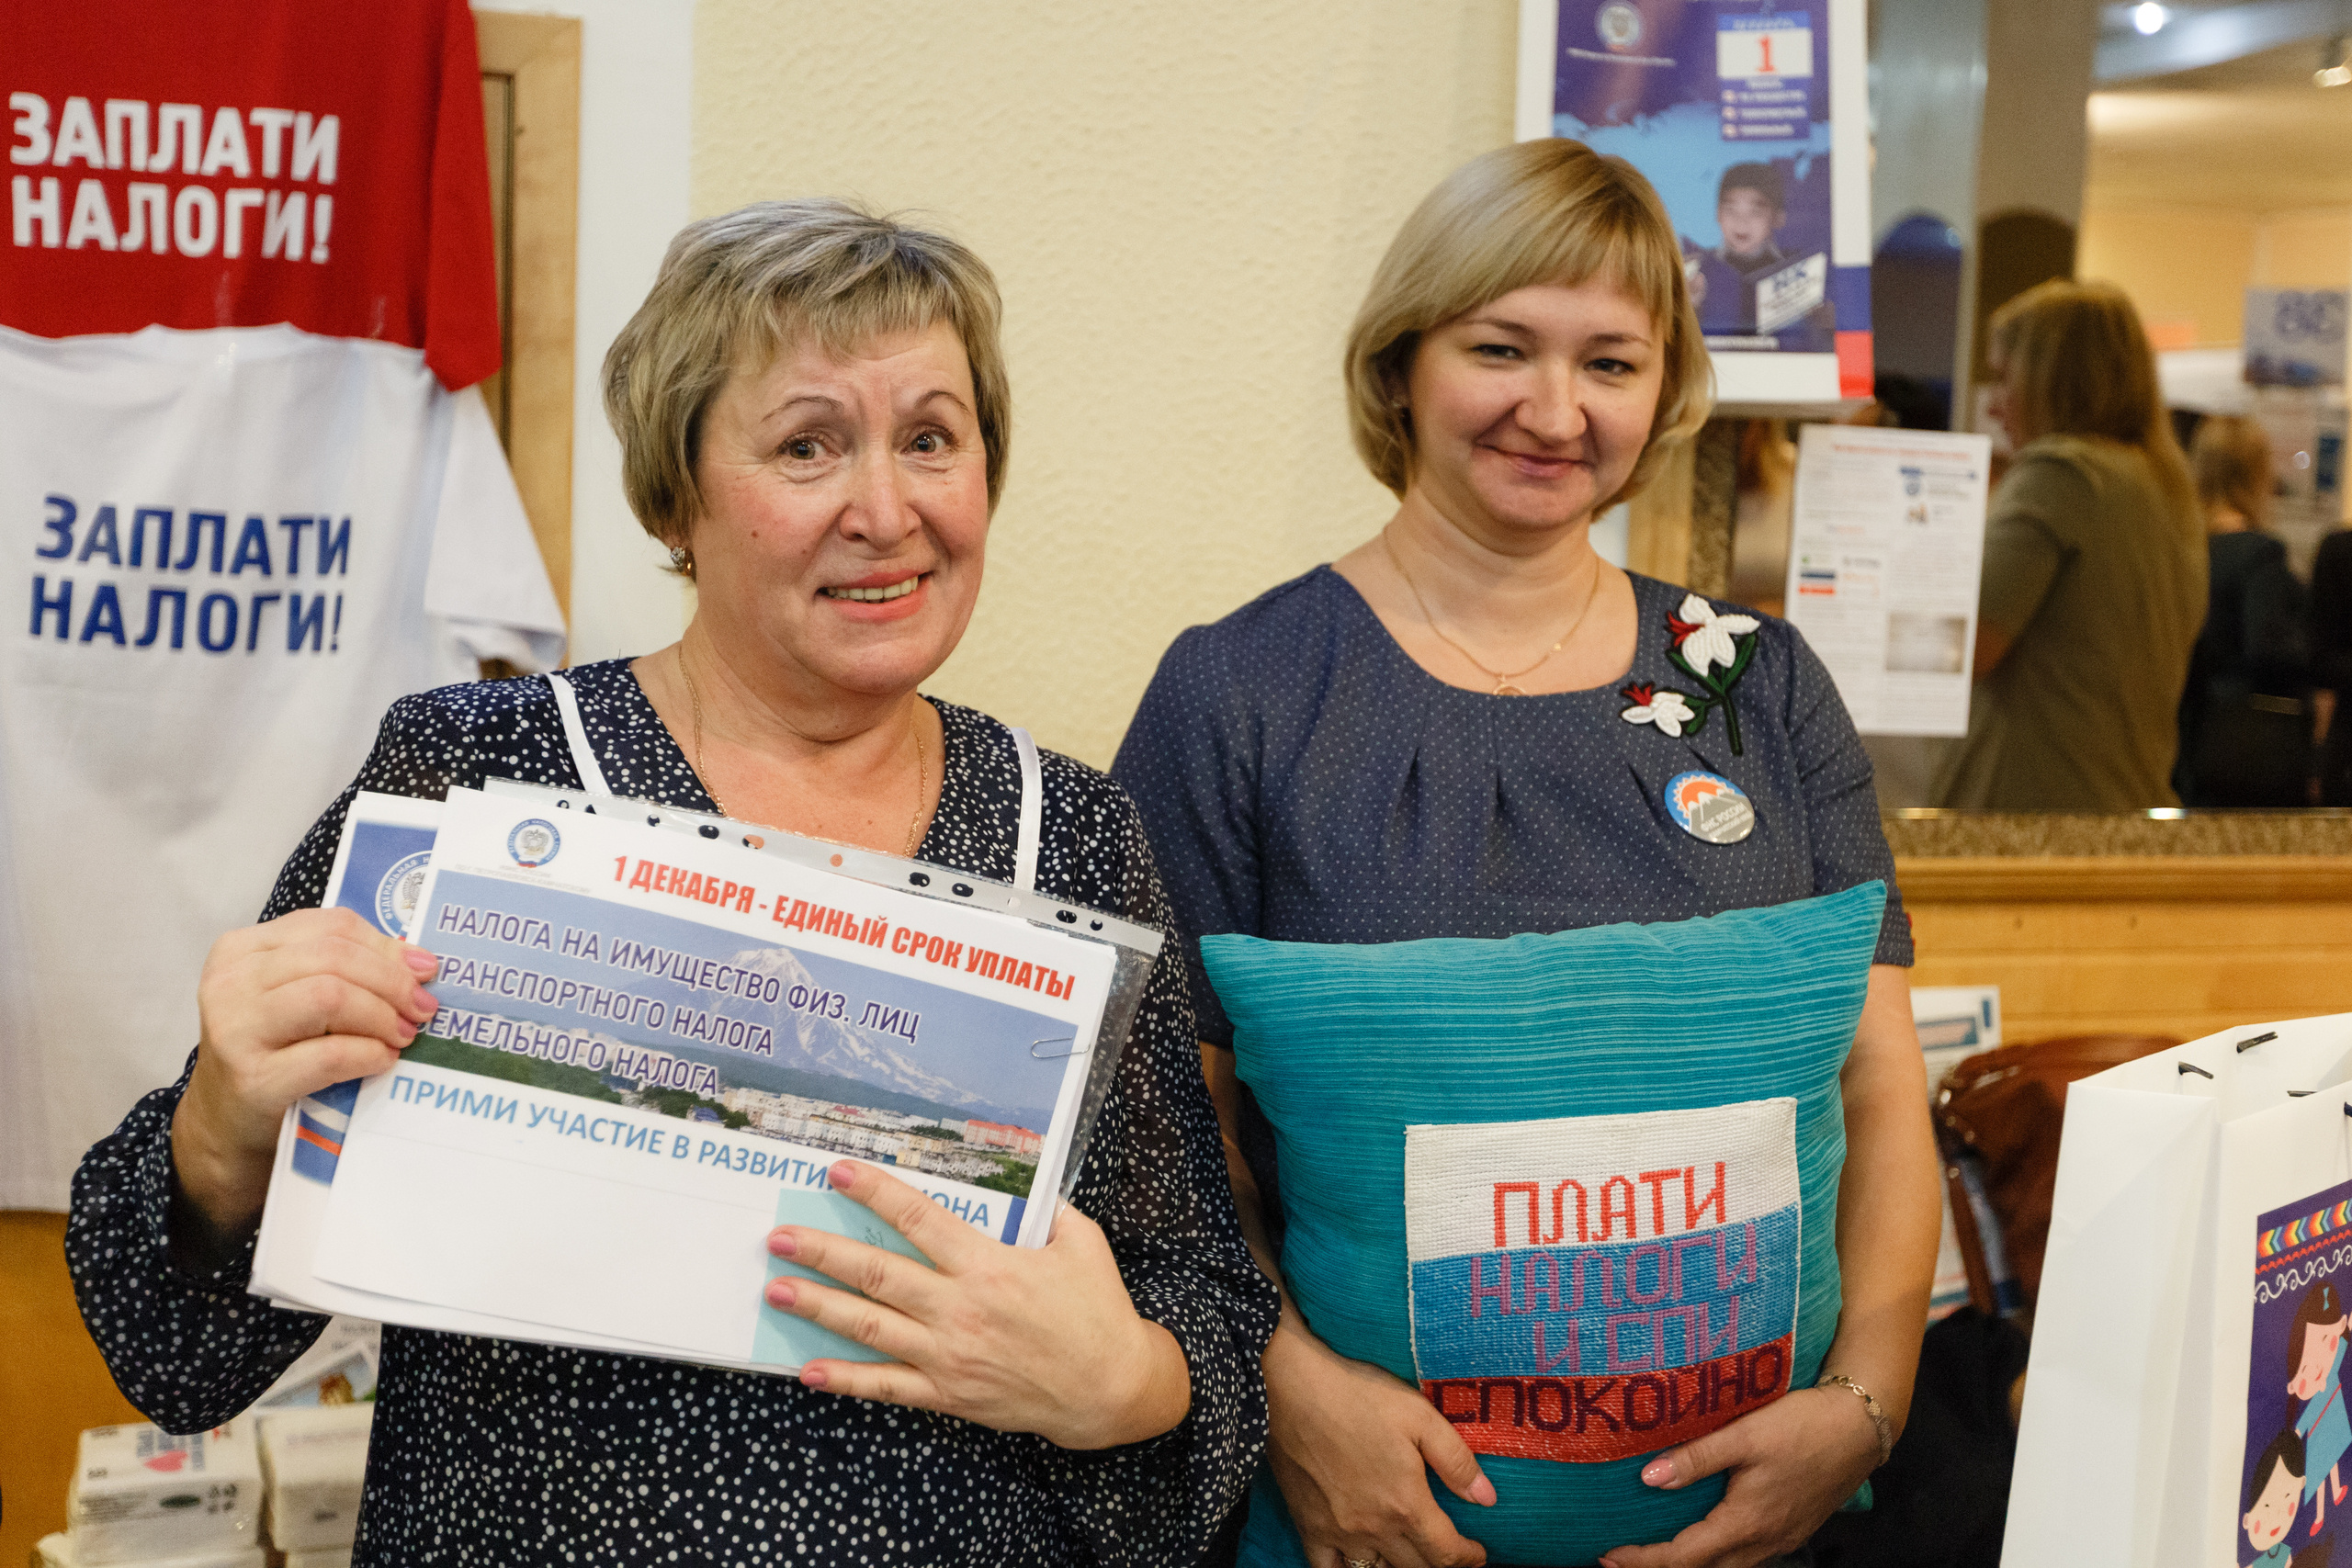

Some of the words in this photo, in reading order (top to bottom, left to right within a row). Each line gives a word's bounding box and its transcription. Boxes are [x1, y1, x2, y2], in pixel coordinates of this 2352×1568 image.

[1756, 36, 1776, 73] 1
[9, 92, 340, 184] ЗАПЛАТИ
[11, 175, 334, 264] НАЛОГИ!
[35, 492, 352, 577] ЗАПЛАТИ
[28, 576, 344, 655] НАЛОГИ!
[381, 859, 419, 919] ФЕДЕРАЛЬНАЯ
[614, 855, 628, 882] 1
[628, 859, 755, 914] ДЕКАБРЯ
[772, 895, 888, 948] ЕДИНЫЙ
[891, 927, 964, 969] СРОК
[965, 946, 1076, 1001] УПЛАТЫ
[438, 904, 551, 951] НАЛОГА
[561, 927, 599, 962] НА
[609, 938, 781, 1003] ИМУЩЕСТВО
[787, 984, 850, 1023] ФИЗ.
[858, 1002, 921, 1045] ЛИЦ
[418, 1007, 607, 1069] ЕМЕЛЬНОГО
[613, 1045, 718, 1096] НАЛОГА
[672, 1008, 775, 1056] НАЛОГА
[389, 1075, 518, 1124] ПРИМИ
[526, 1102, 665, 1155] УЧАСТИЕ
[671, 1134, 691, 1159] В
[696, 1140, 831, 1191] РАЗВИТИ
[1493, 1162, 1726, 1247] ПЛАТИ
[1470, 1224, 1757, 1317] НАЛОГИ
[1534, 1319, 1580, 1373] И
[1606, 1295, 1740, 1372] СПИ
